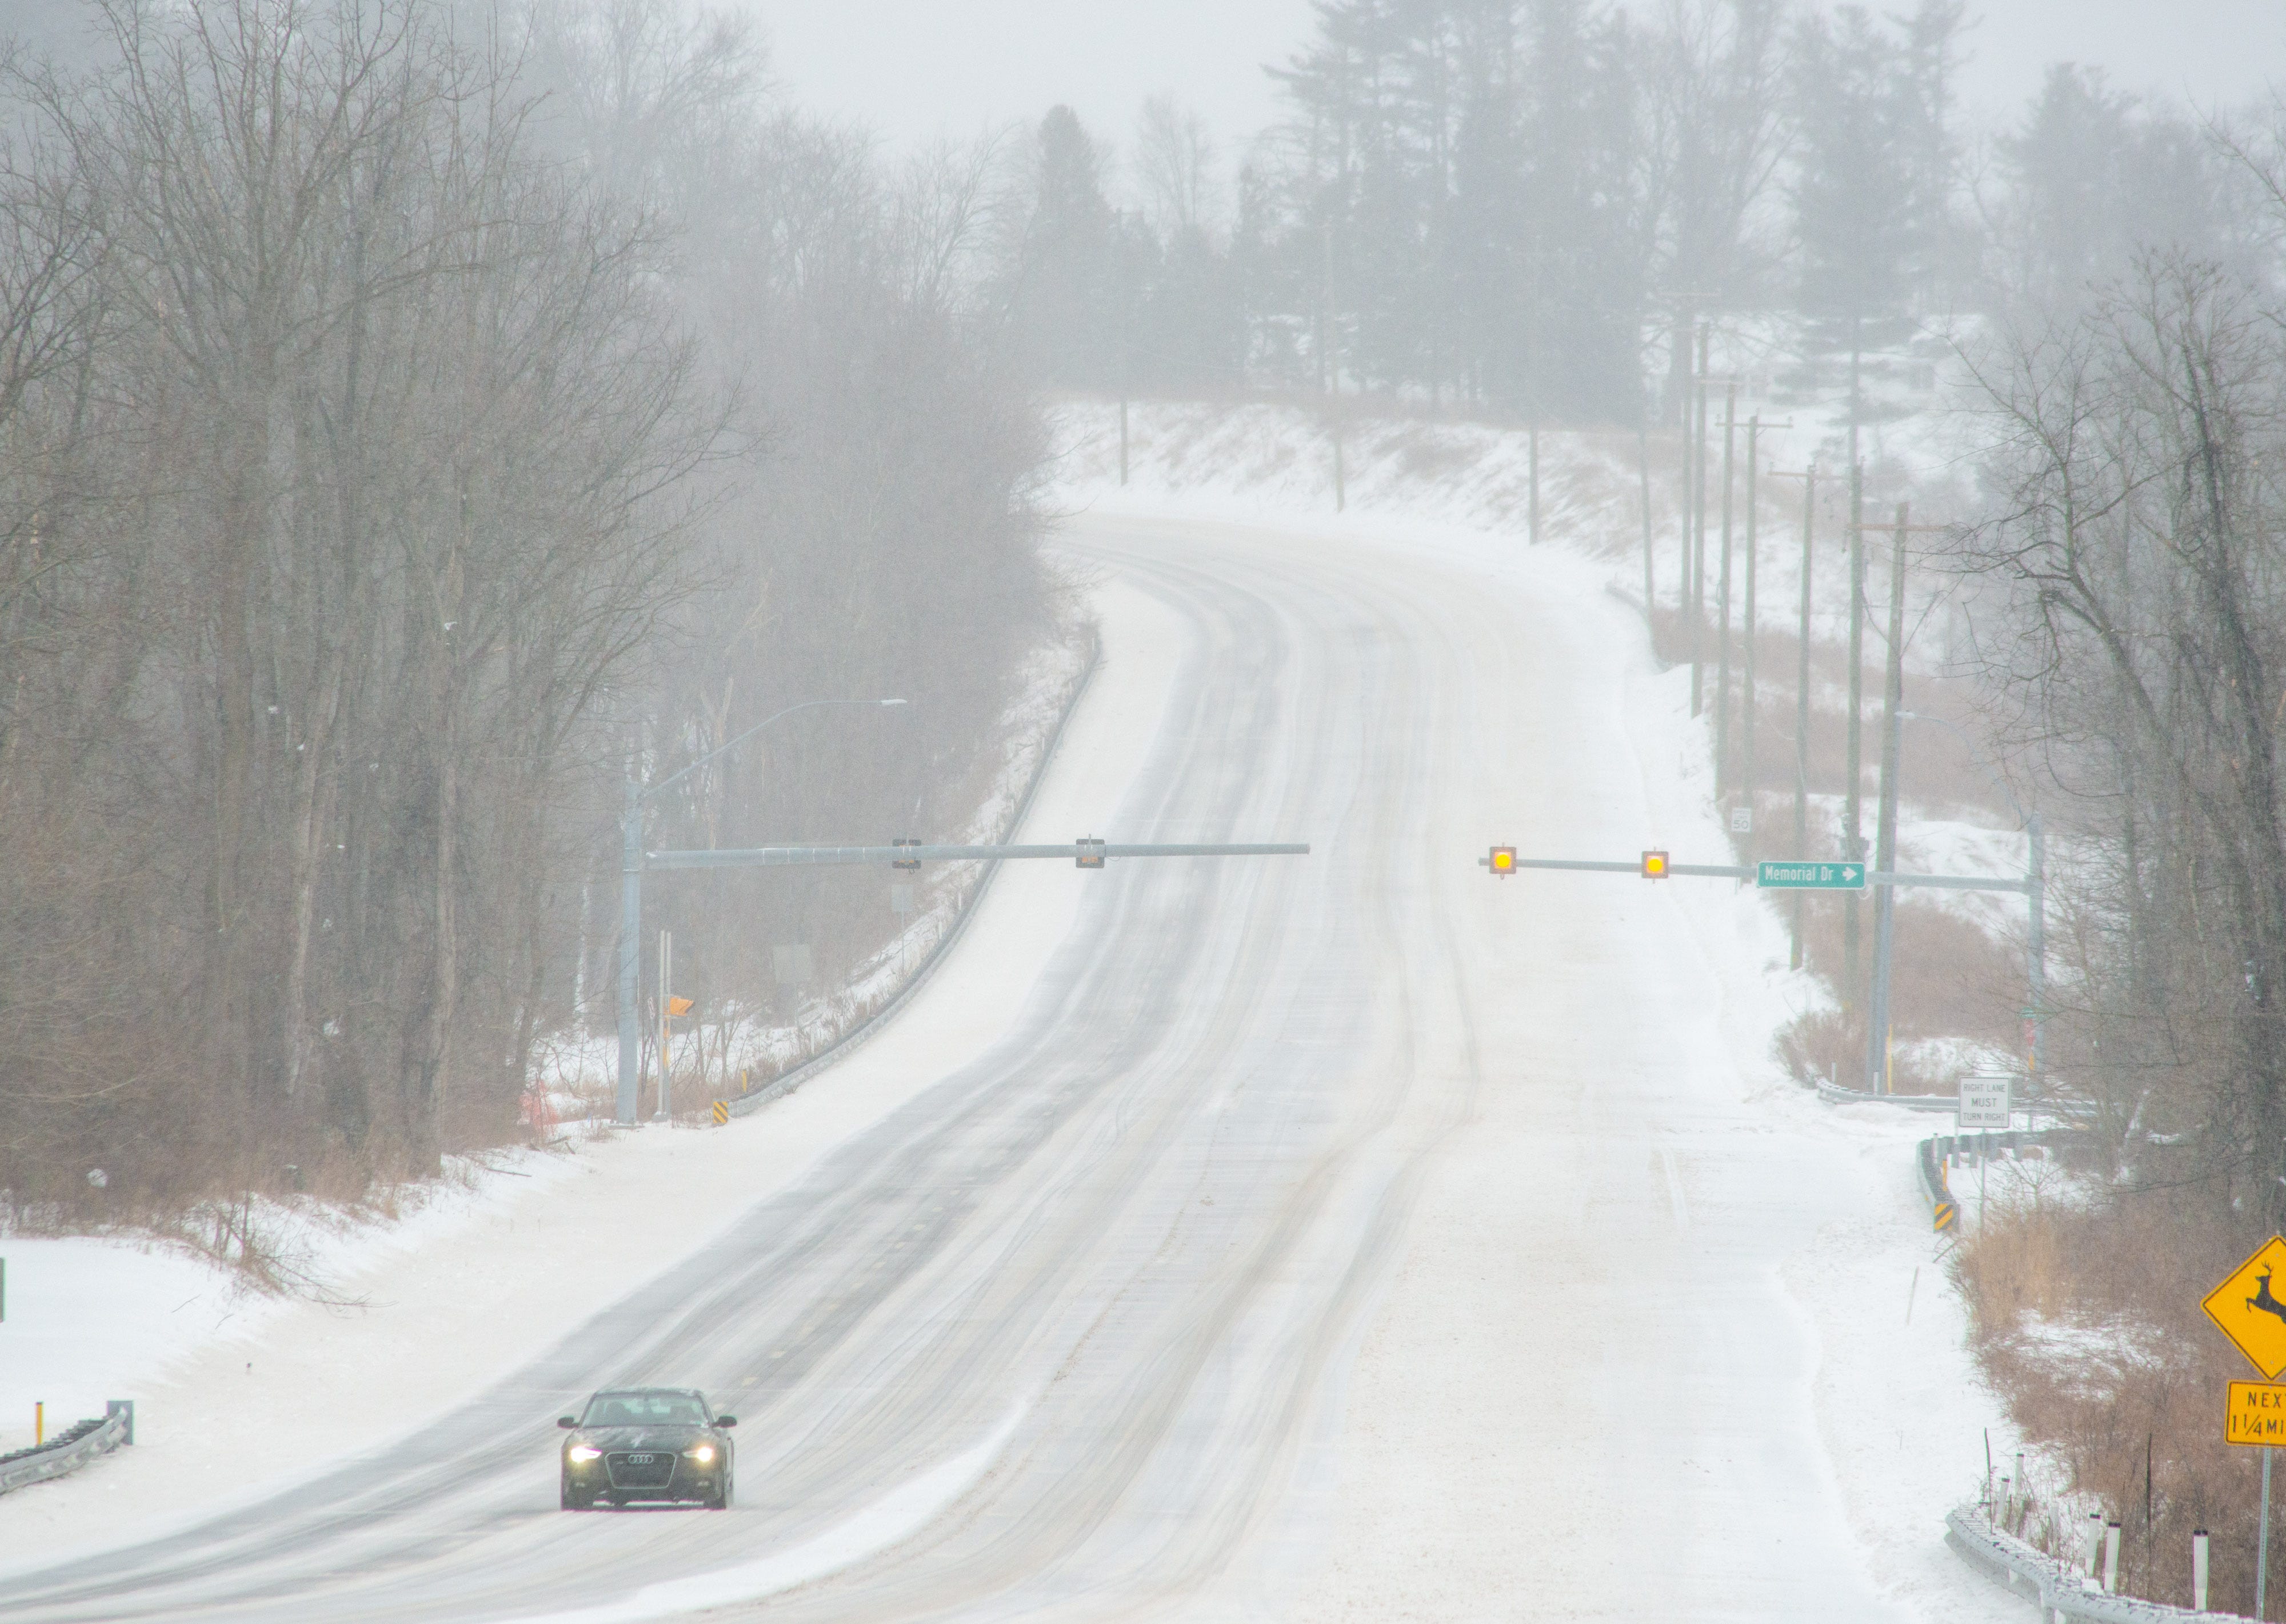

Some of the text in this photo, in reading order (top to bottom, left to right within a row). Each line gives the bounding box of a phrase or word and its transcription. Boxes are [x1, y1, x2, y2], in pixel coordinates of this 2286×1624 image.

[1733, 819, 1748, 829] 50
[1765, 865, 1834, 881] Memorial Dr
[1963, 1083, 2005, 1093] RIGHT LANE
[1971, 1098, 1997, 1107] MUST
[1963, 1112, 2005, 1121] TURN RIGHT
[2248, 1391, 2286, 1408] NEX
